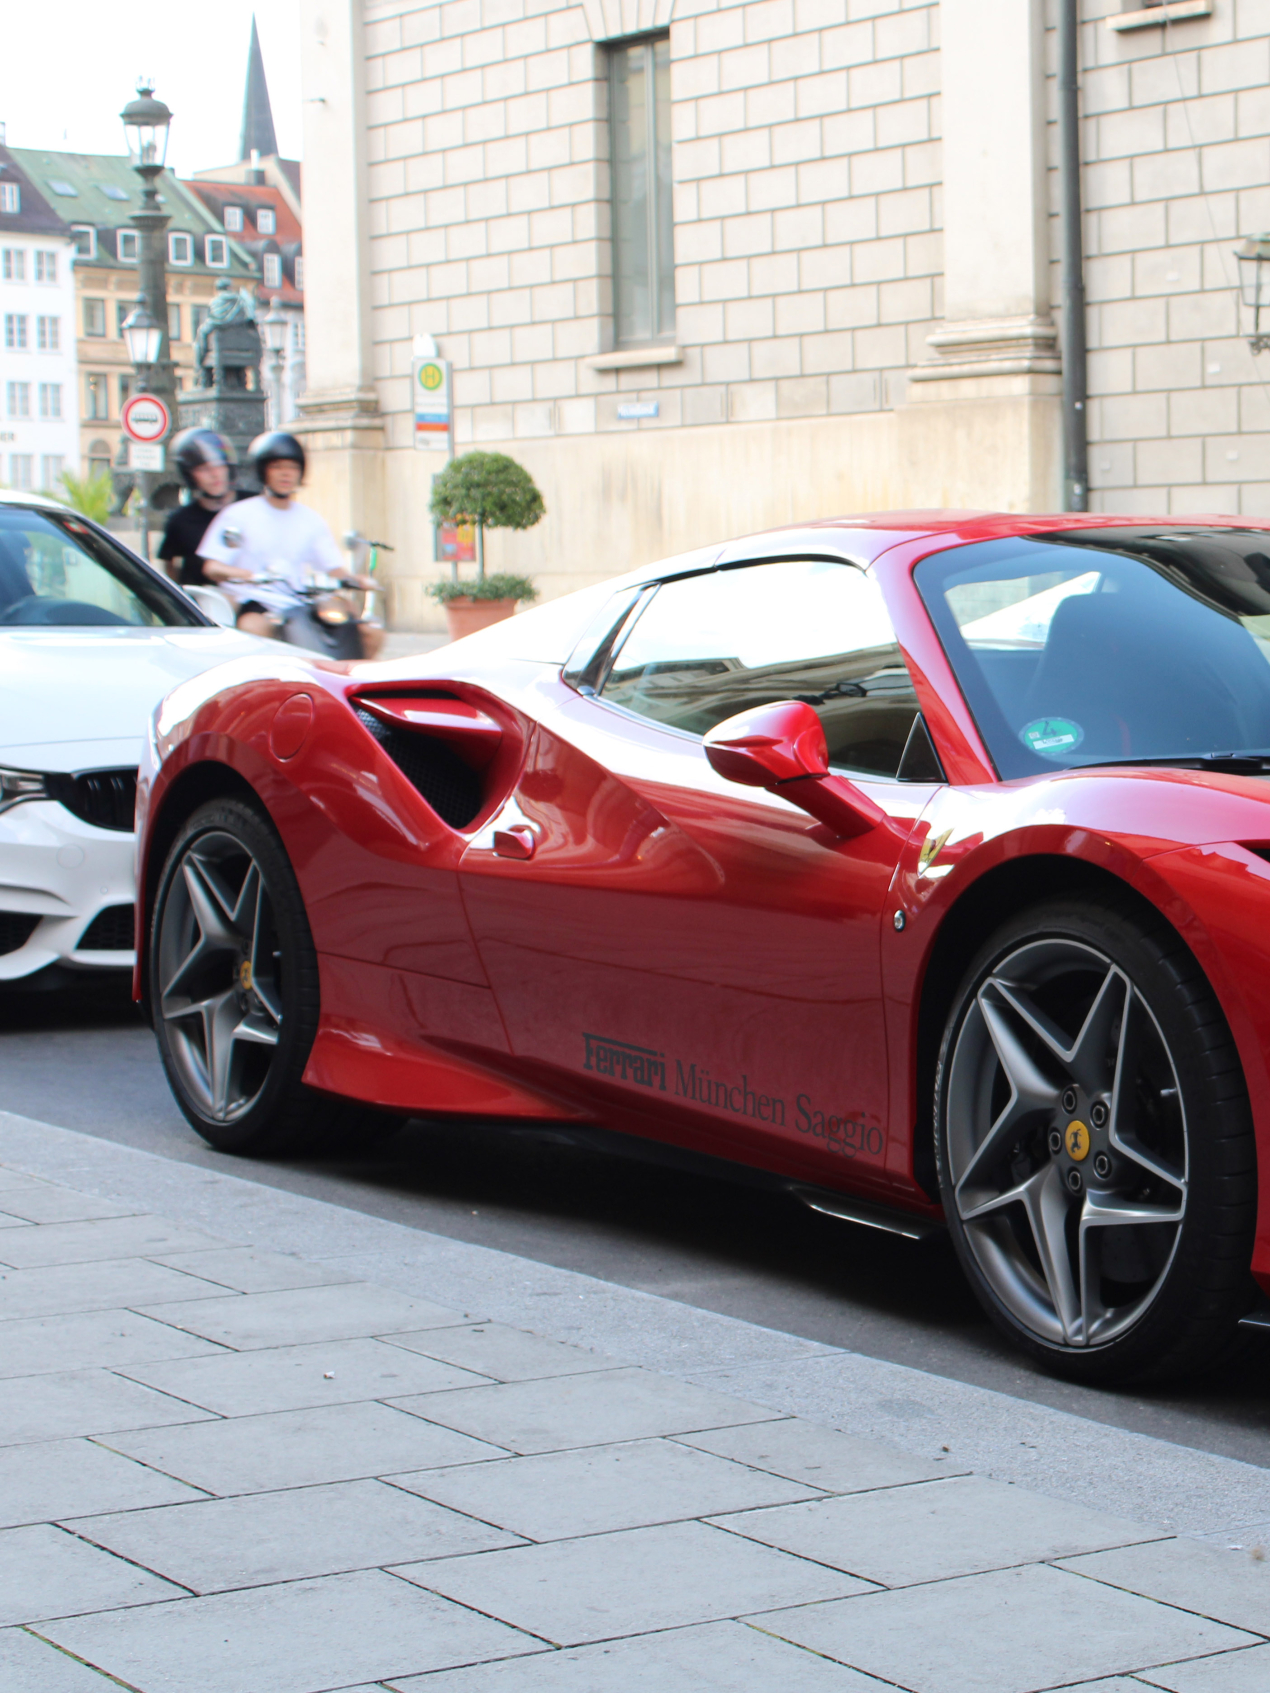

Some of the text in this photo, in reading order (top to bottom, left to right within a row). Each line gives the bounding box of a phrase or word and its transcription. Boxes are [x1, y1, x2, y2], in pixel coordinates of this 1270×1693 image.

[582, 1032, 667, 1091] Ferrari
[674, 1059, 787, 1127] München
[795, 1093, 883, 1159] Saggio
